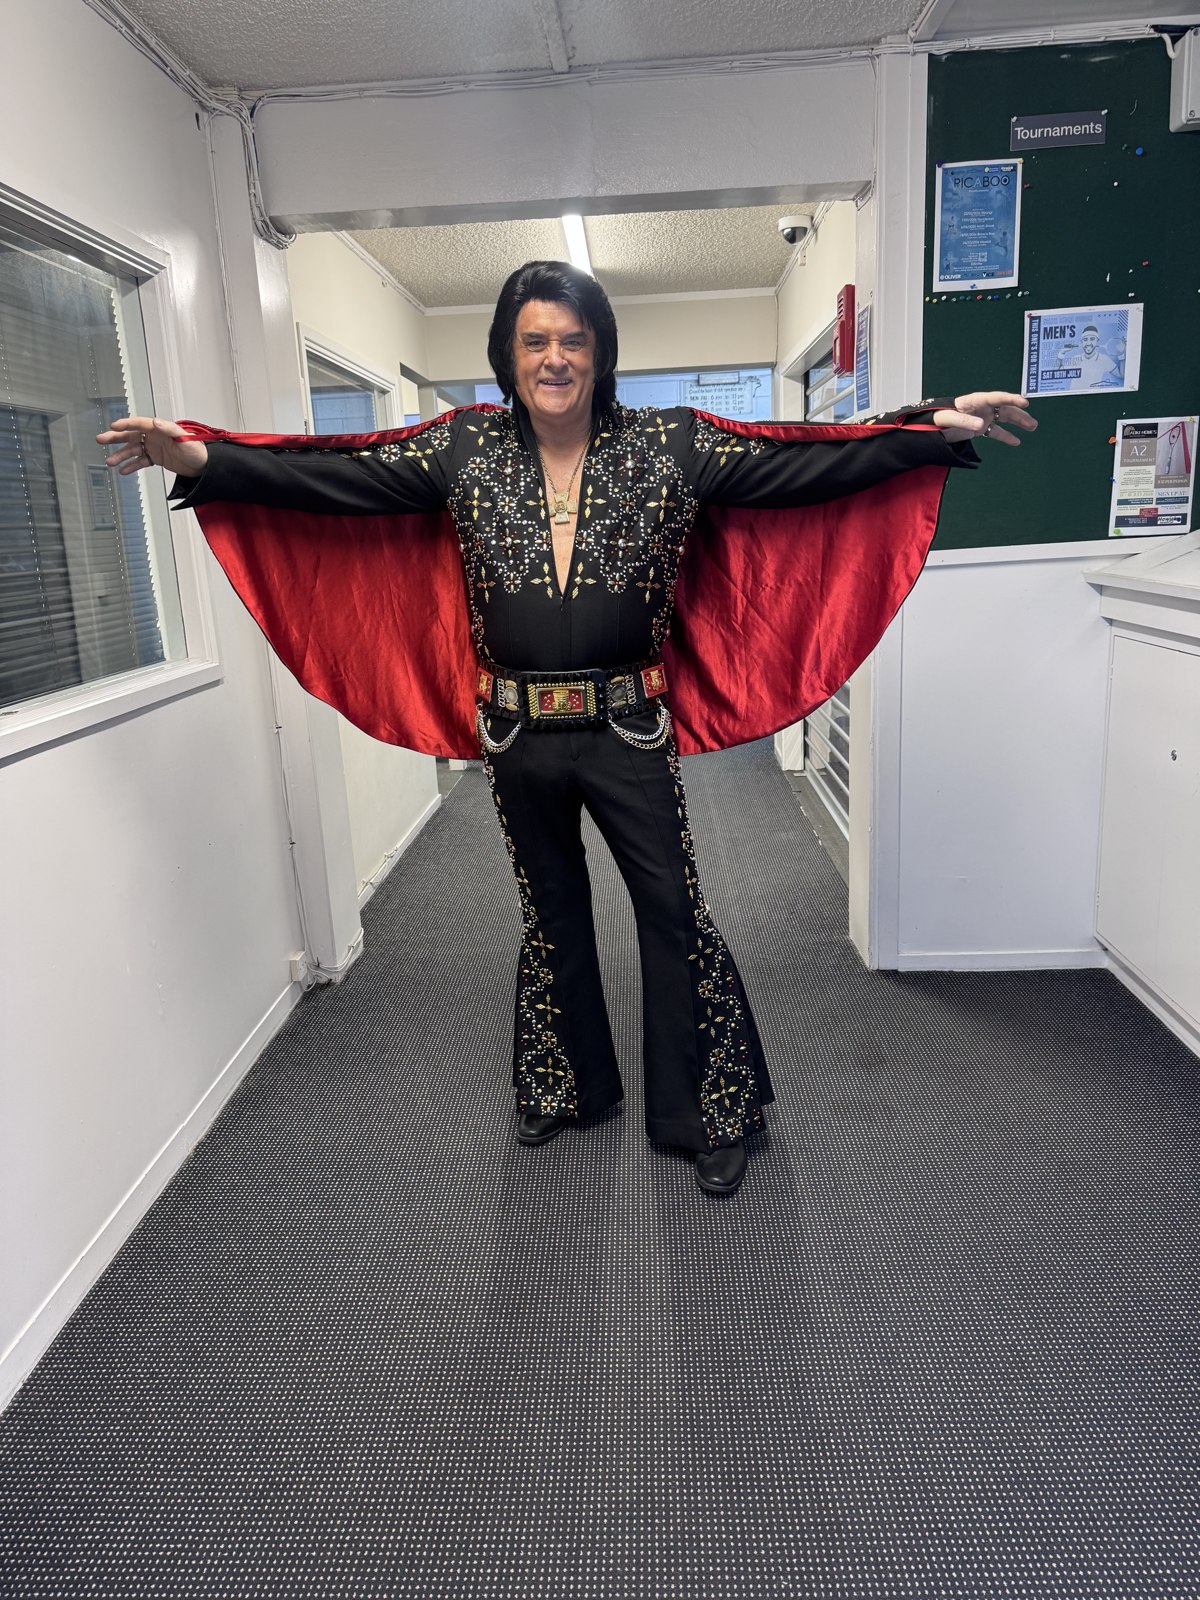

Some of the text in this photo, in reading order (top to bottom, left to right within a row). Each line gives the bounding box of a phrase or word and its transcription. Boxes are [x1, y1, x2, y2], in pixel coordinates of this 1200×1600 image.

[1015, 122, 1102, 140] Tournaments
[953, 175, 1010, 189] PICABOO
[1031, 319, 1039, 332] THIS
[1042, 324, 1076, 340] MEN'S
[1030, 351, 1038, 363] FOR
[1029, 363, 1037, 375] THE
[1042, 369, 1081, 380] SAT 18TH JULY
[1029, 375, 1037, 391] LADS
[1130, 445, 1148, 456] A2
